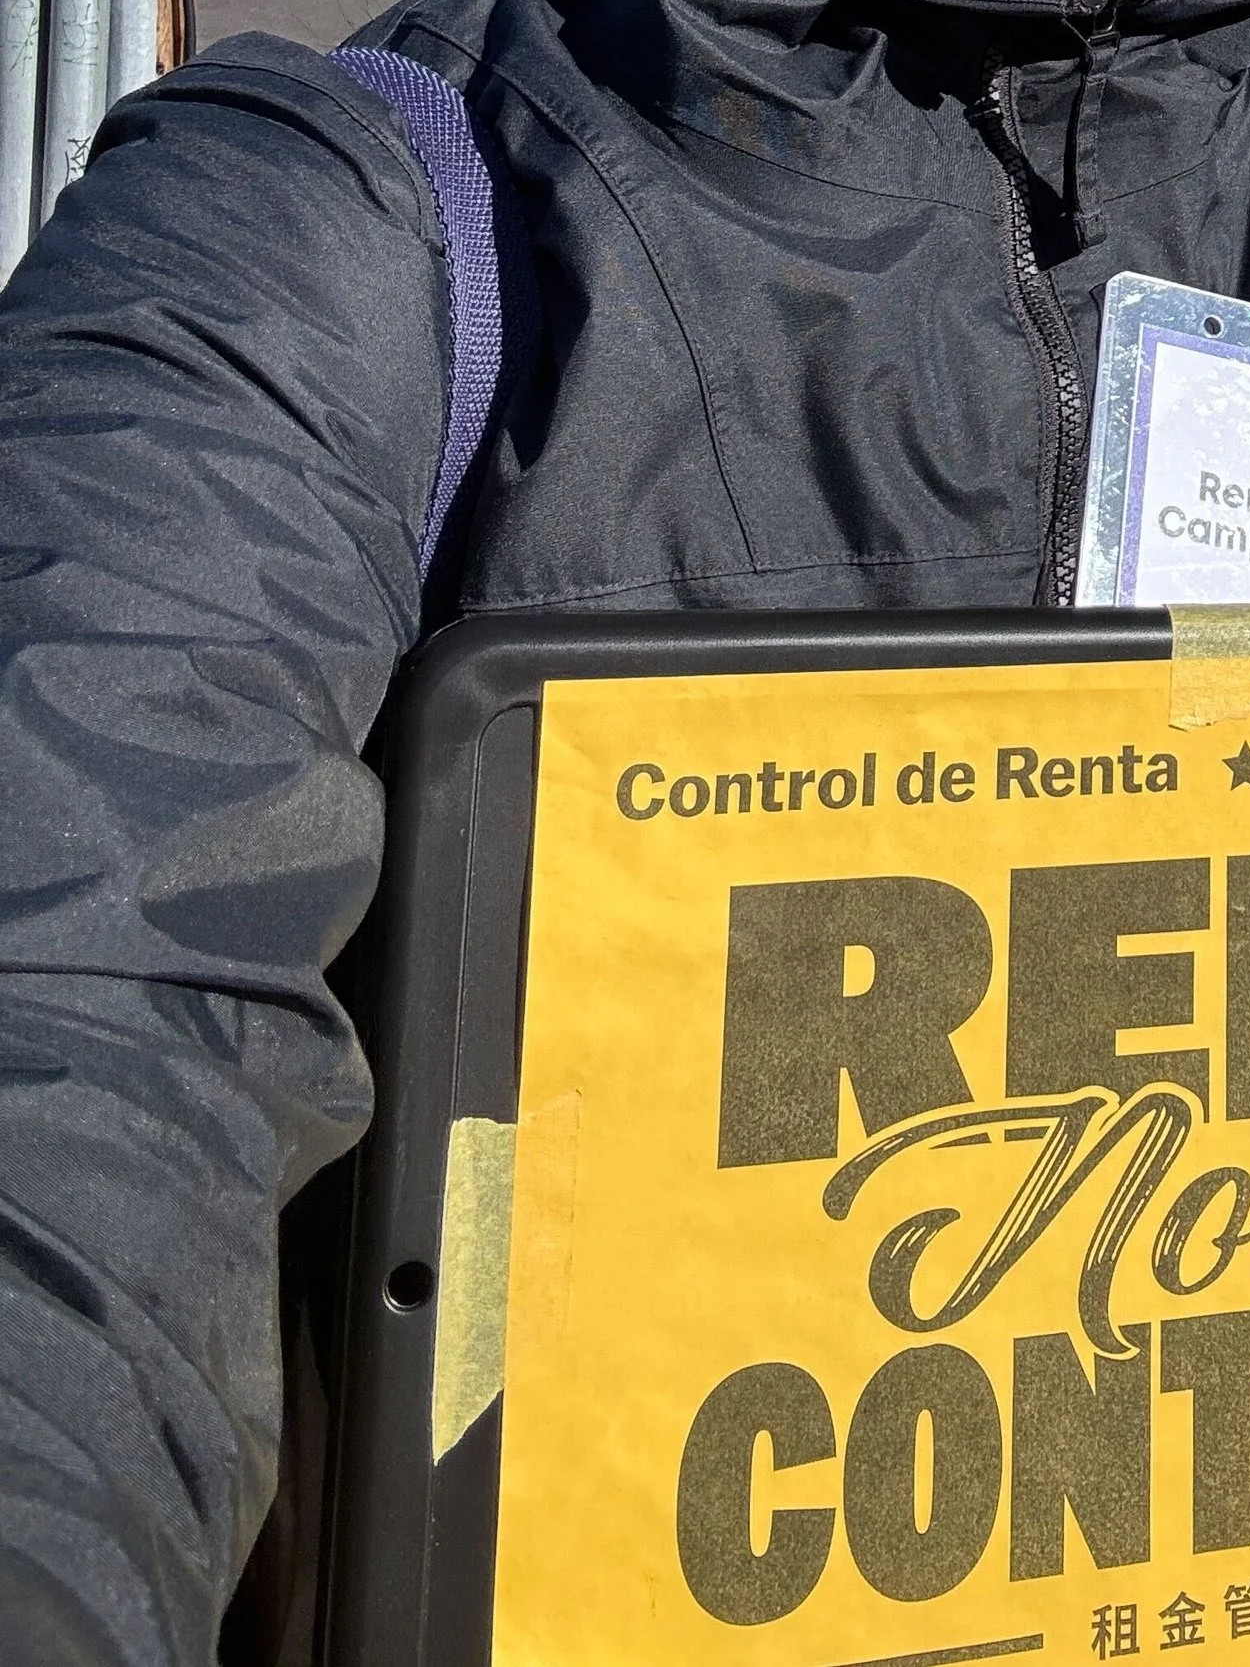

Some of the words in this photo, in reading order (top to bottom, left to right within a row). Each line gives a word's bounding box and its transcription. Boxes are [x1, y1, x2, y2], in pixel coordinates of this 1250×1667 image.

[616, 752, 877, 821] Control
[896, 751, 976, 805] de
[996, 745, 1179, 800] Renta
